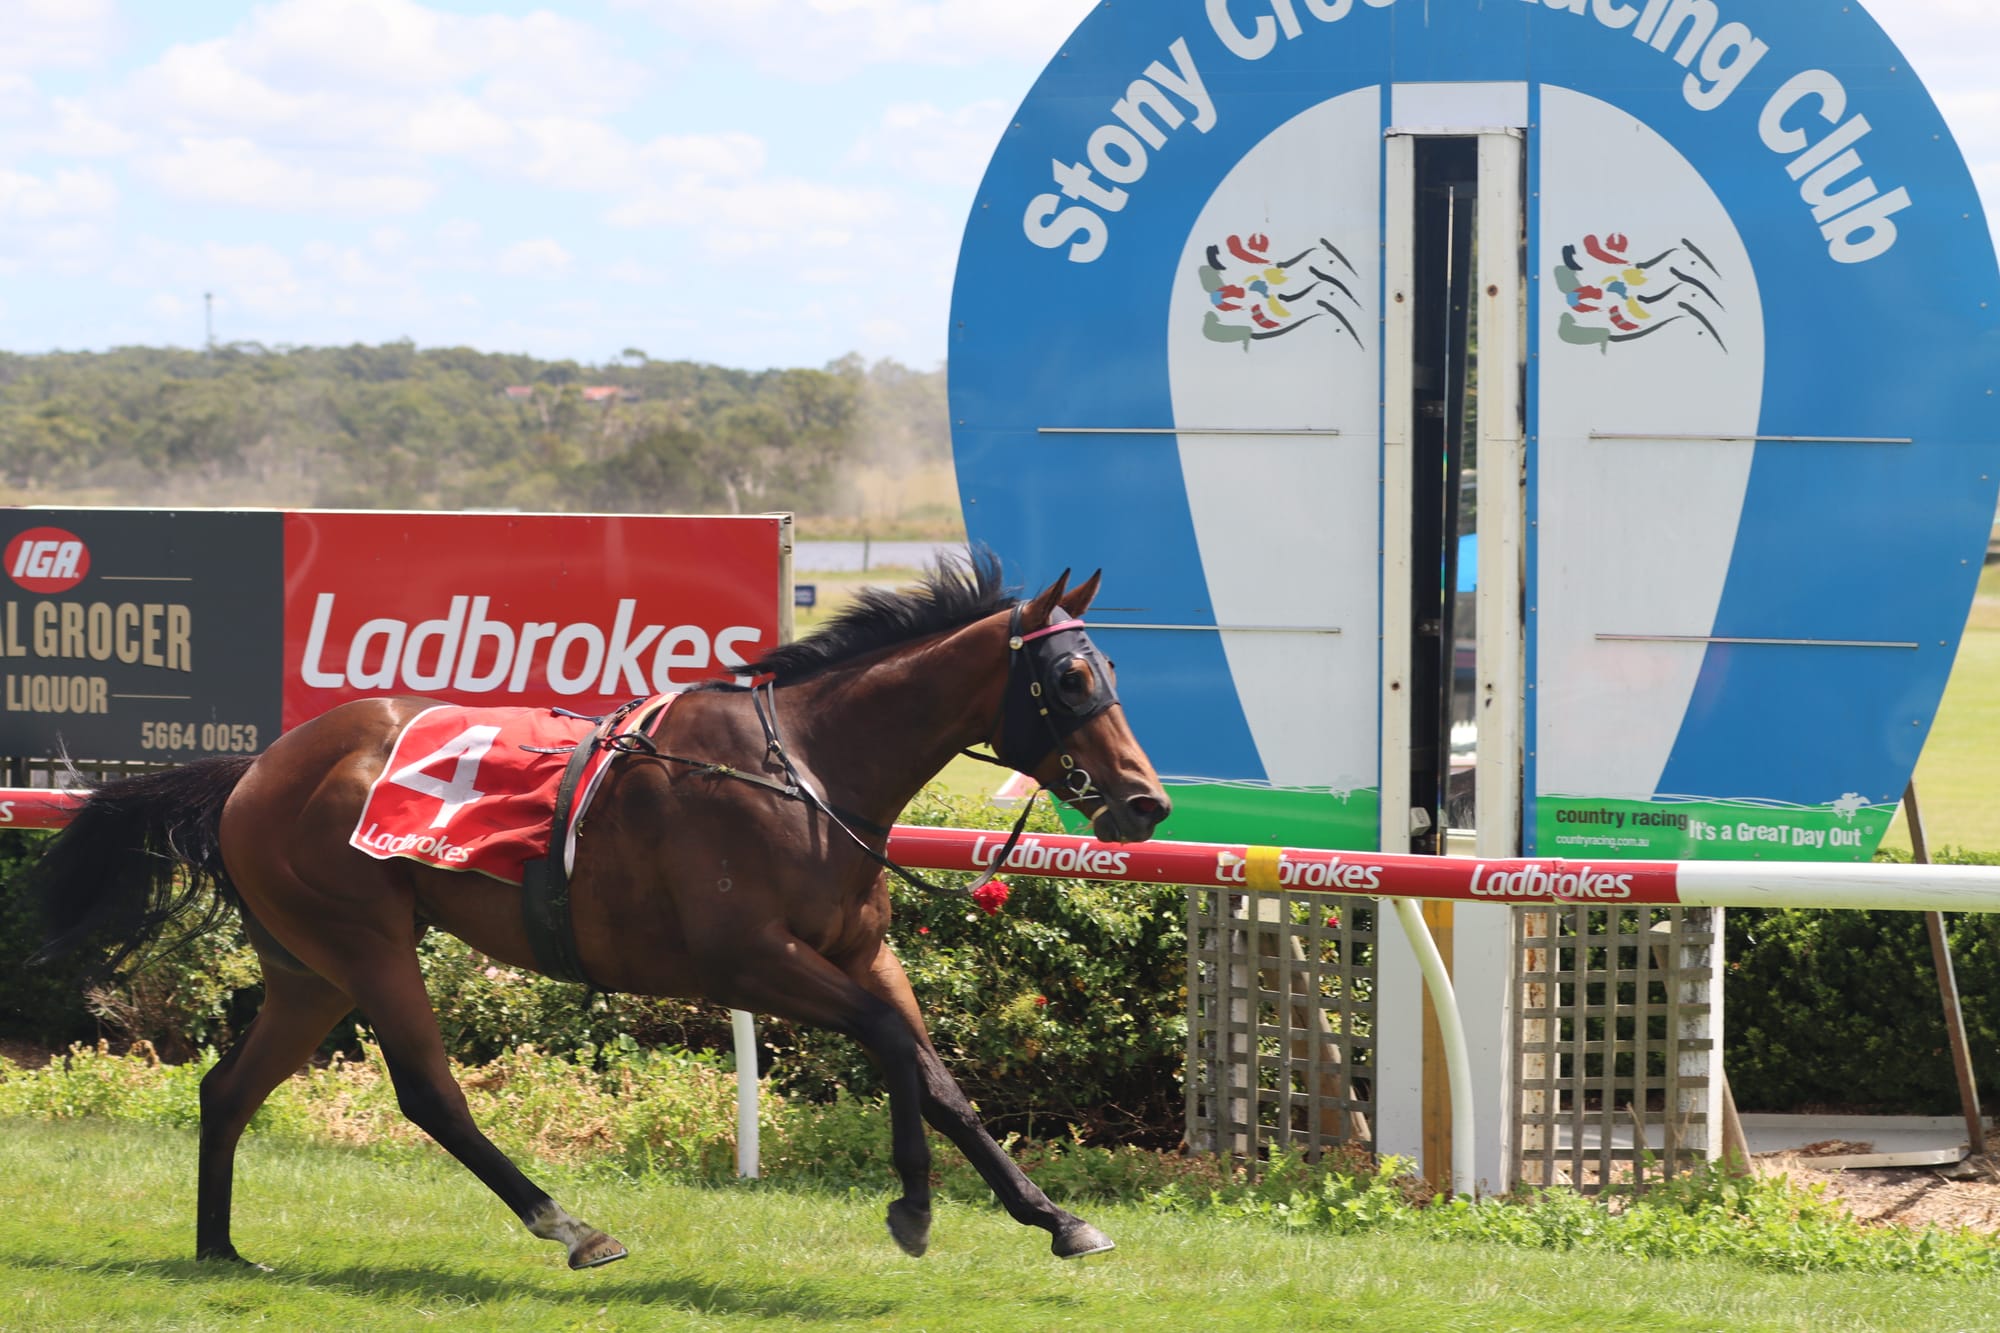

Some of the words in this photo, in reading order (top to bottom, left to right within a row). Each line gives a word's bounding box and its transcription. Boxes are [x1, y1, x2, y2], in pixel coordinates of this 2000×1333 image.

[1023, 36, 1218, 264] Stony
[1758, 69, 1913, 264] Club
[12, 541, 83, 578] IGA
[33, 600, 192, 672] GROCER
[301, 592, 762, 696] Ladbrokes
[6, 674, 109, 714] LIQUOR
[141, 722, 197, 750] 5664
[202, 724, 258, 752] 0053
[390, 725, 501, 829] 4
[1556, 808, 1626, 829] country
[1631, 810, 1689, 831] racing
[1689, 819, 1717, 842] It's
[1721, 824, 1733, 841] a
[1791, 827, 1826, 849] Day
[1829, 827, 1863, 847] Out
[1555, 834, 1650, 849] countryracing.com.au
[1215, 852, 1384, 890] Labrokes
[1469, 863, 1634, 899] Ladbrokes
